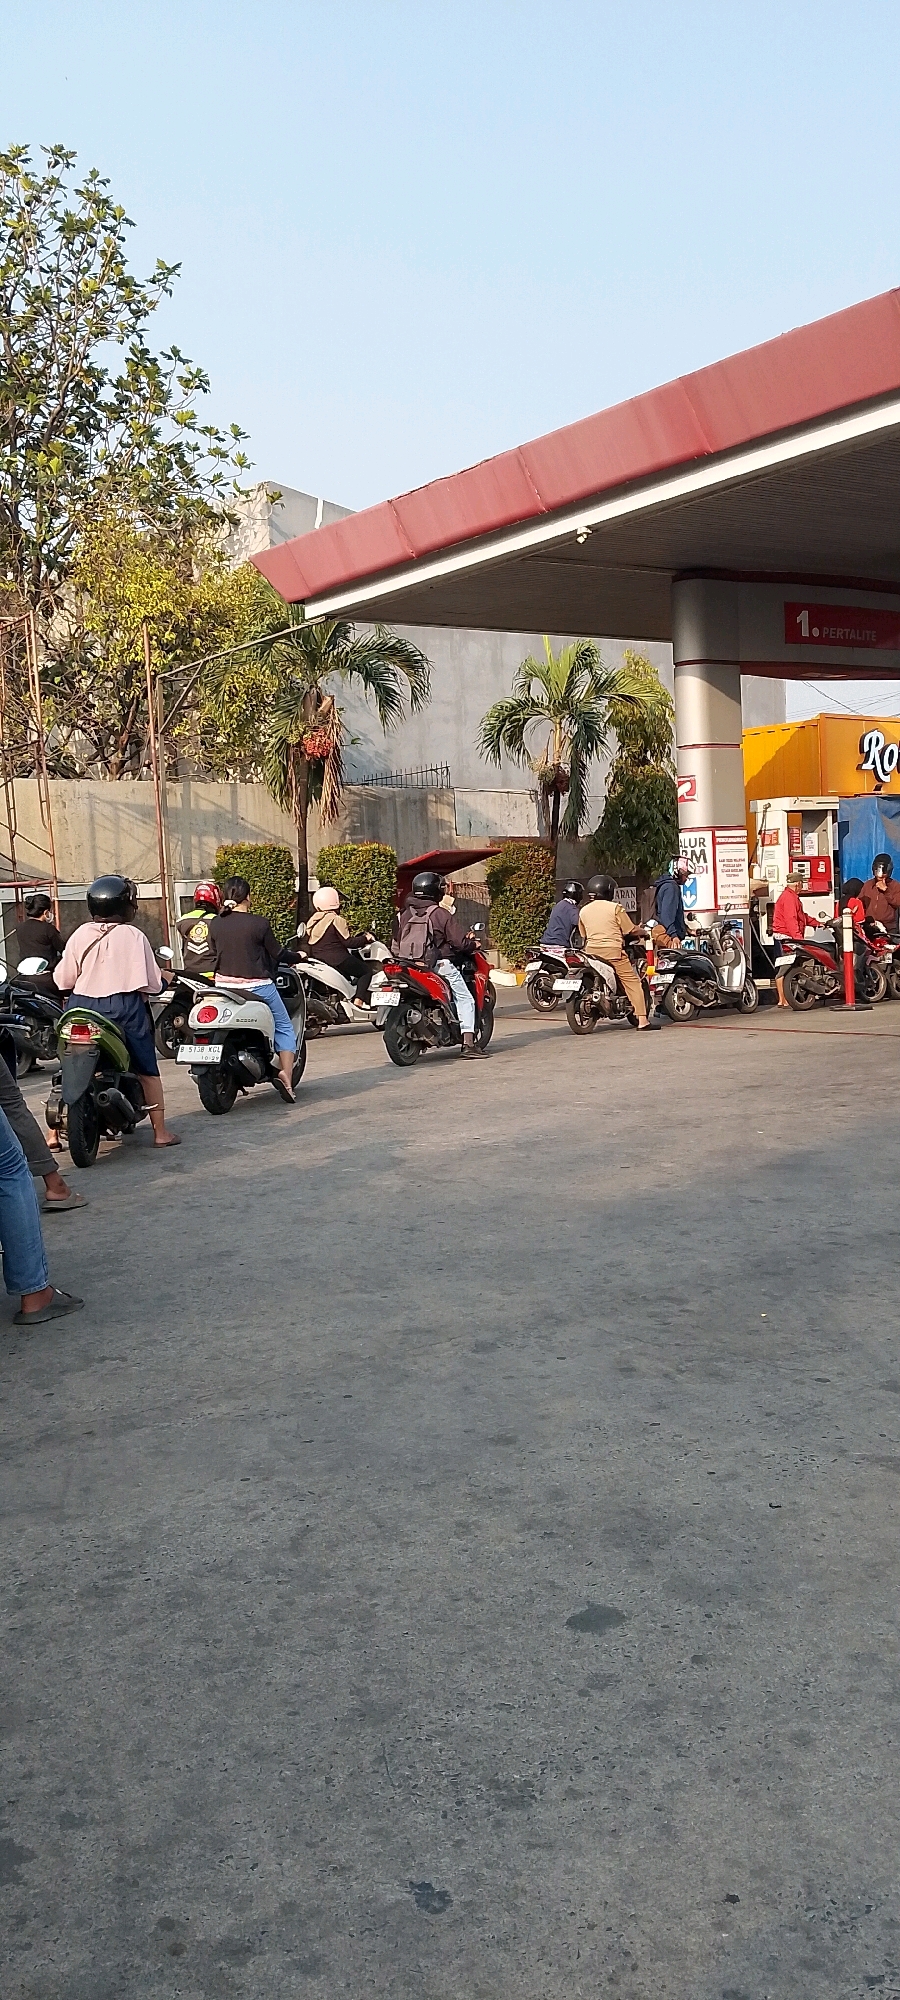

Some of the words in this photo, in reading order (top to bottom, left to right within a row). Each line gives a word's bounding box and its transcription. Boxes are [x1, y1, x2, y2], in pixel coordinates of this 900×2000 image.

[797, 610, 820, 637] 1.
[823, 627, 877, 641] PERTALITE
[861, 729, 900, 783] Ro
